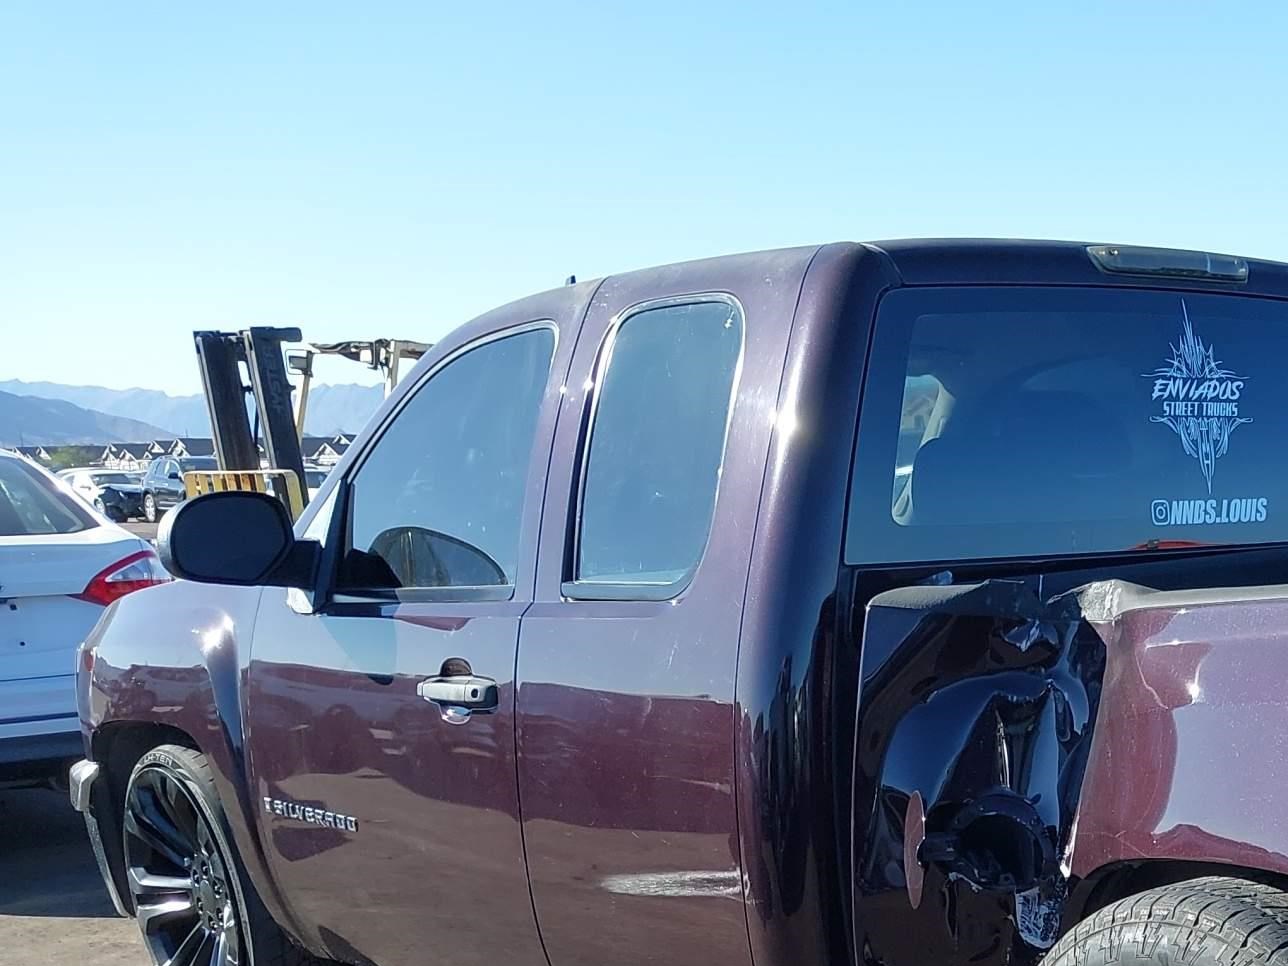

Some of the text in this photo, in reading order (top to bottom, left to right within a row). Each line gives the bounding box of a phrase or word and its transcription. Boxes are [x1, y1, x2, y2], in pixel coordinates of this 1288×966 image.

[1152, 379, 1243, 400] ENVIADOS
[1163, 401, 1238, 416] STREET TRUCKS
[1170, 498, 1267, 525] NNBS.LOUIS
[273, 800, 358, 832] SILVERADO
